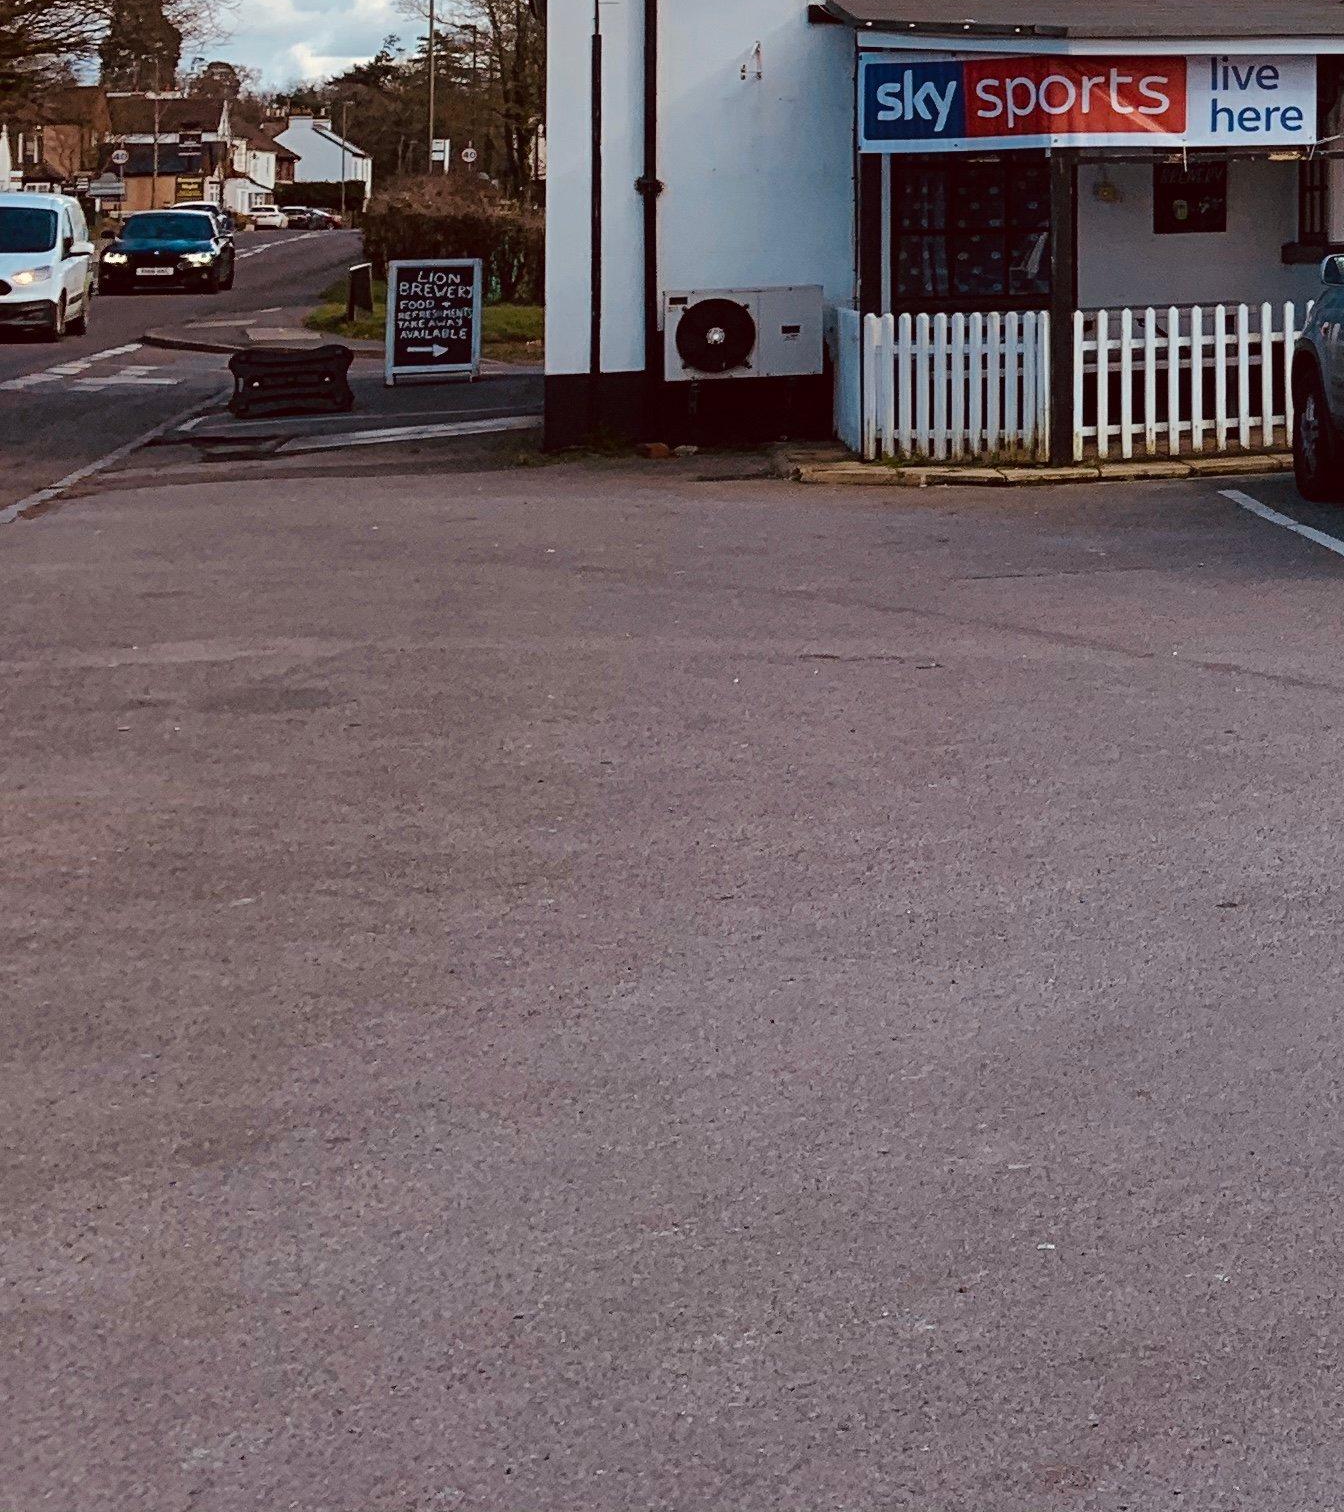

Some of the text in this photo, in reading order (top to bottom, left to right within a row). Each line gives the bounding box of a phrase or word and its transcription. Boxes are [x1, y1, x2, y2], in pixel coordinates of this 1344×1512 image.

[1210, 56, 1280, 91] live
[876, 67, 1171, 133] sky sports
[1210, 98, 1304, 133] here
[417, 271, 460, 284] LION
[399, 282, 473, 298] BREWERY
[400, 300, 435, 309] FOOD
[397, 319, 425, 329] TAKE
[400, 328, 467, 339] AVAILABLE
